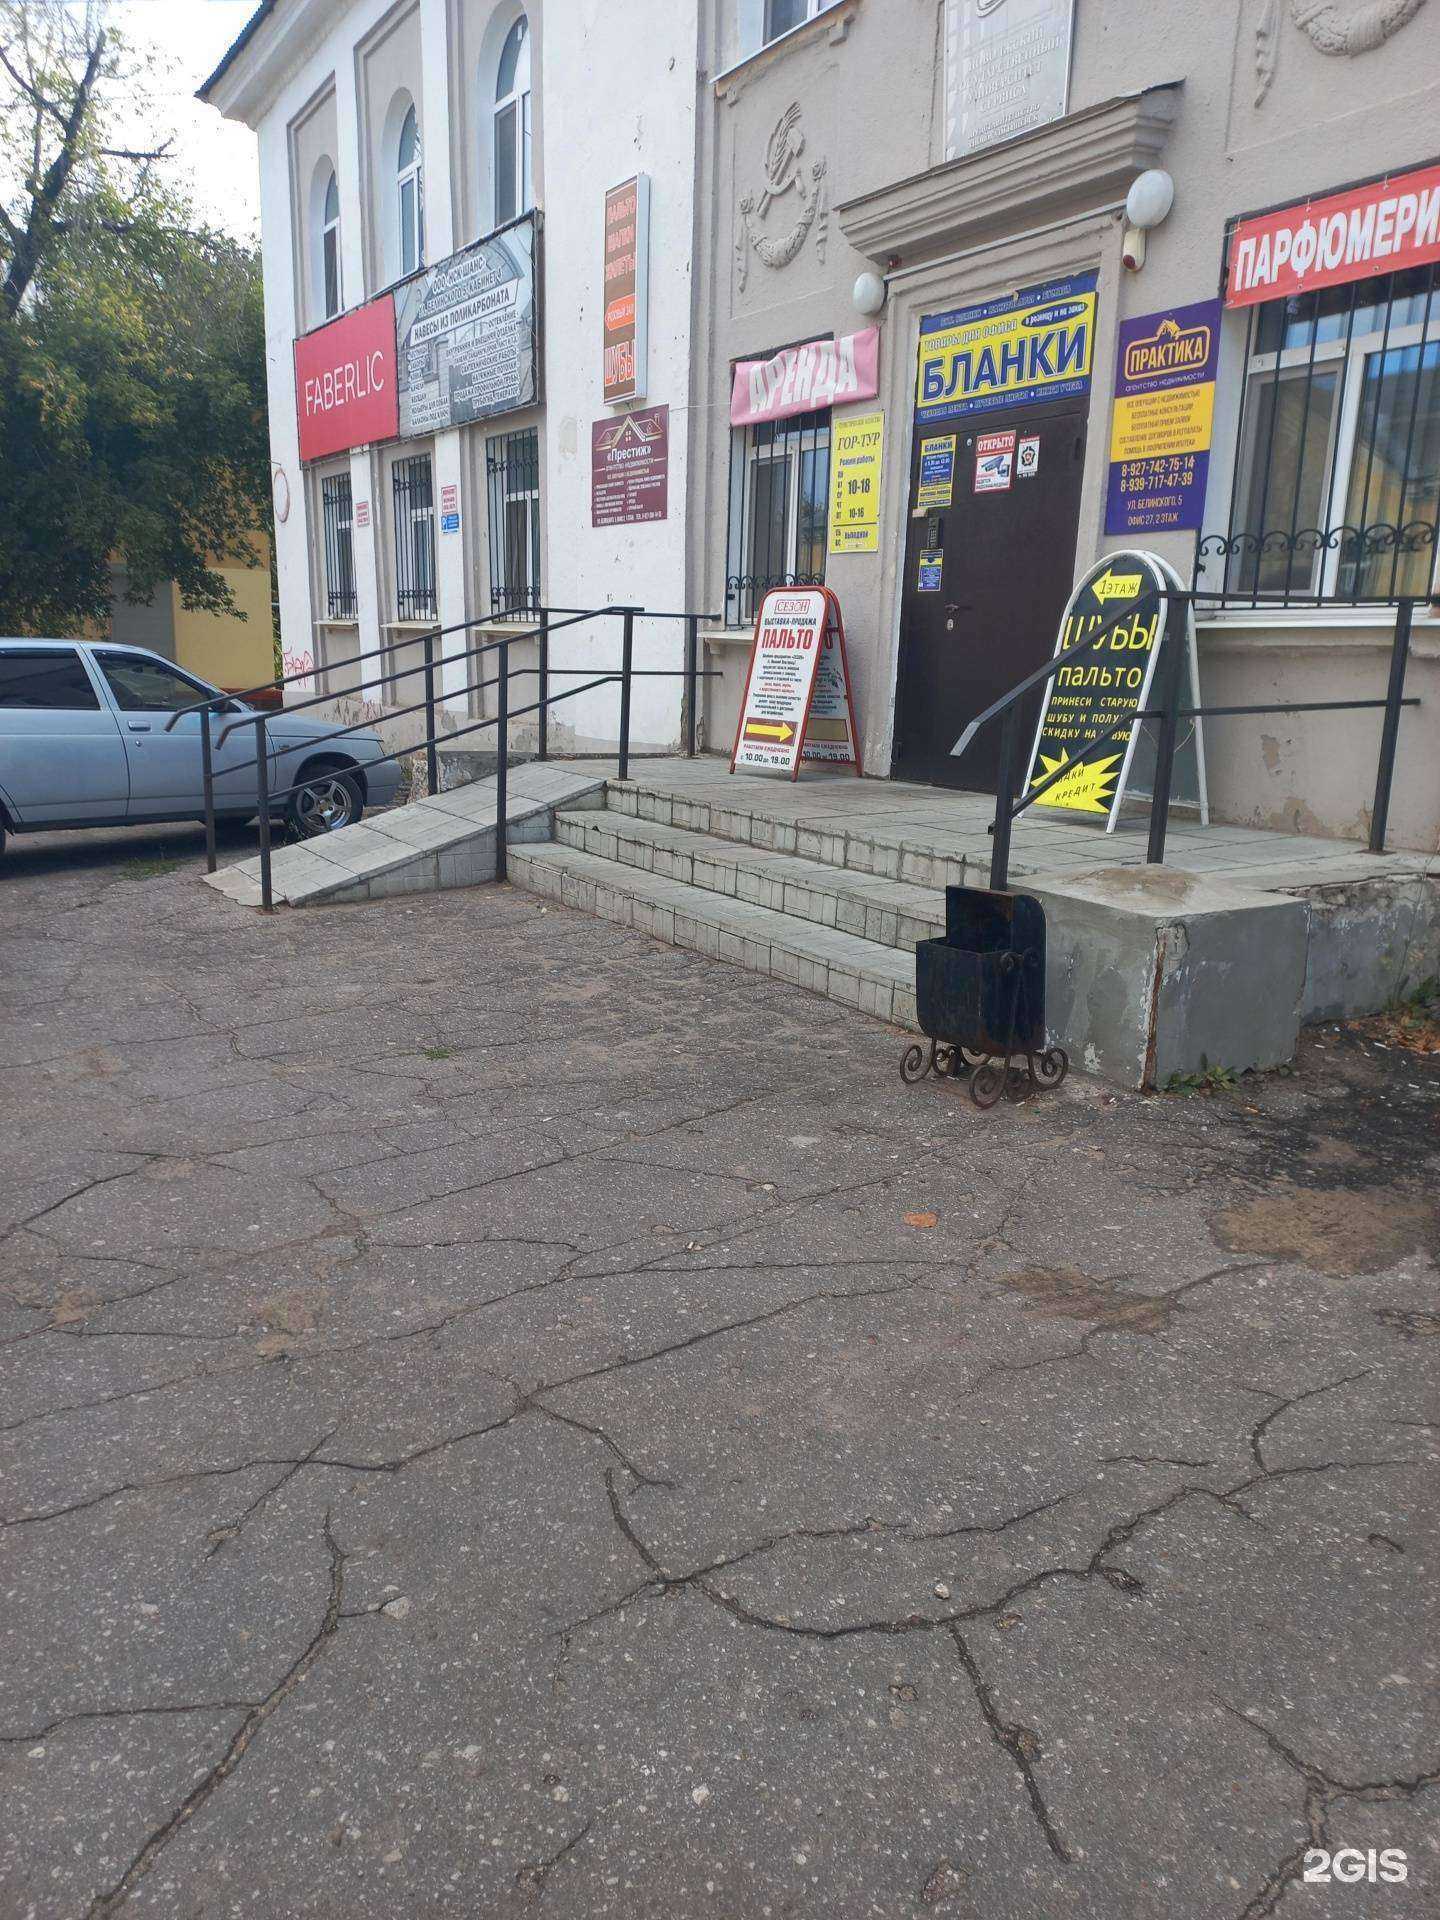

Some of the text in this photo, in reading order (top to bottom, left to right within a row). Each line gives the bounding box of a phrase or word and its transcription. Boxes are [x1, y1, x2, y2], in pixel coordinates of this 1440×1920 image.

[1234, 185, 1440, 292] ПАРФЮМЕРИ
[414, 287, 510, 341] НАВЕСЫ ИЗ ПОЛИКАРБОНАТА
[1029, 309, 1053, 326] розницу
[1059, 307, 1067, 317] на
[924, 319, 1017, 352] ТОВАРЫ ДЛЯ ОФИСА
[605, 339, 636, 387] ШУБЫ
[922, 323, 1088, 402] БЛАНКИ
[1130, 336, 1203, 372] ПРАКТИКА
[305, 350, 384, 417] FABERLIC
[750, 335, 858, 414] АРЕНДА
[837, 431, 881, 452] ГОР-ТУР
[925, 440, 953, 452] БЛАНКИ
[977, 434, 1014, 452] ОТКРЫТО
[606, 444, 652, 463] «Престиж»
[1122, 455, 1195, 478] 8-927-742-75-14
[847, 477, 871, 496] 10-18
[1120, 471, 1193, 493] 8-939-717-47-39
[1178, 494, 1183, 506] 5
[849, 507, 865, 519] 10-16
[1127, 514, 1145, 527] ОФИС
[1160, 511, 1179, 524] ЭТАЖ
[777, 600, 808, 613] СЕЗОН
[764, 617, 817, 627] ВЫСТАВКА-ПРОДАЖА
[761, 628, 814, 650] ПАЛЬТО
[1051, 697, 1138, 708] ПРИНЕСИ СТАРУЮ
[1047, 713, 1133, 725] ШУБУ И ПОЛУ
[1042, 727, 1080, 740] СКИДКУ
[1084, 729, 1096, 739] НА
[745, 752, 764, 762] 10.00
[770, 755, 791, 765] 19.00
[1055, 783, 1096, 801] КРЕДИТ
